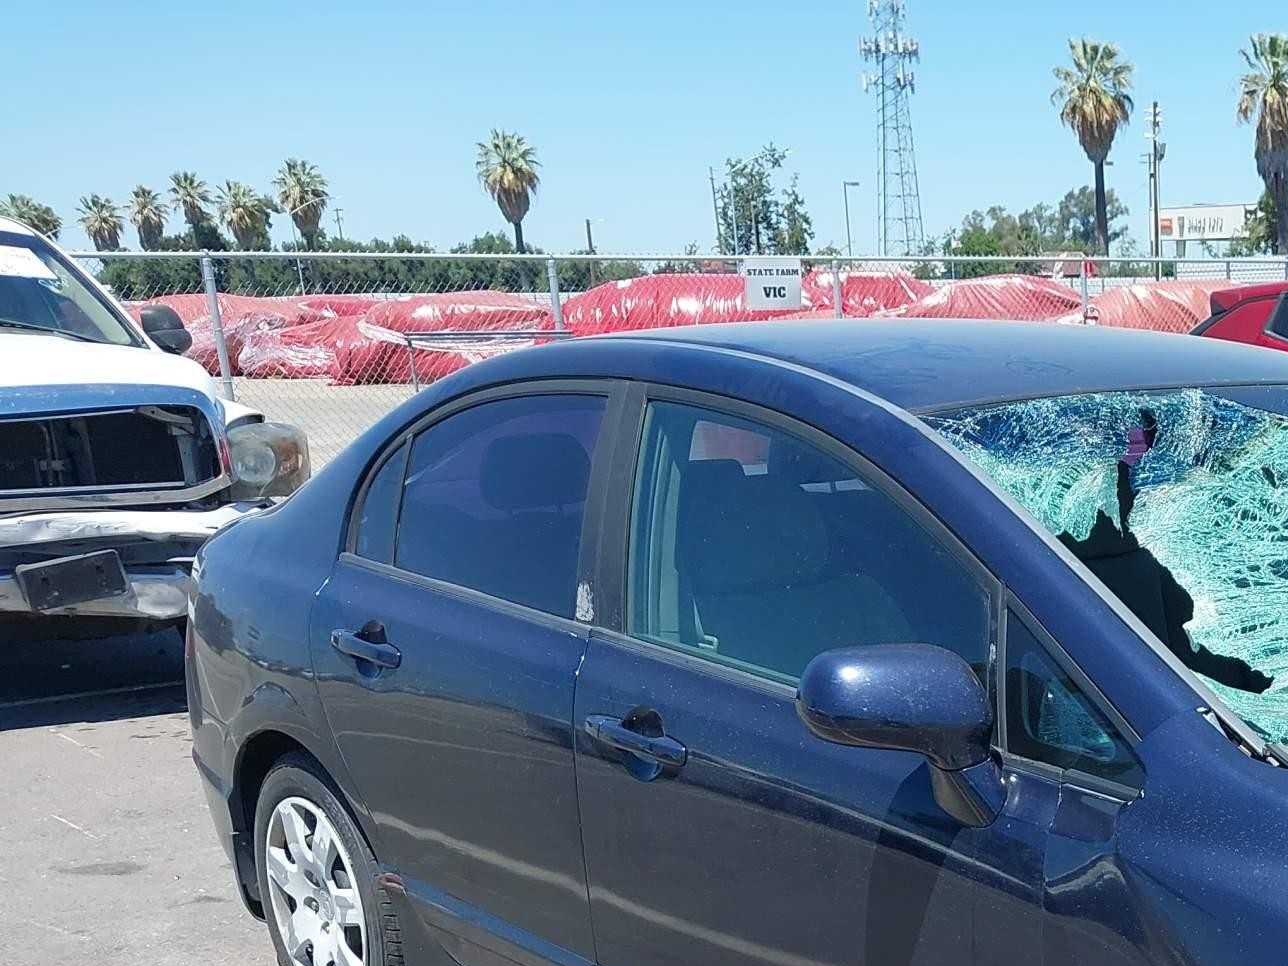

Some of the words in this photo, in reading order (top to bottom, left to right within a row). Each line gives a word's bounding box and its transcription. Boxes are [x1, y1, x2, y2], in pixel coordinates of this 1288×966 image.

[746, 268, 774, 276] STATE
[775, 268, 799, 276] FARM
[762, 286, 787, 298] VIC
